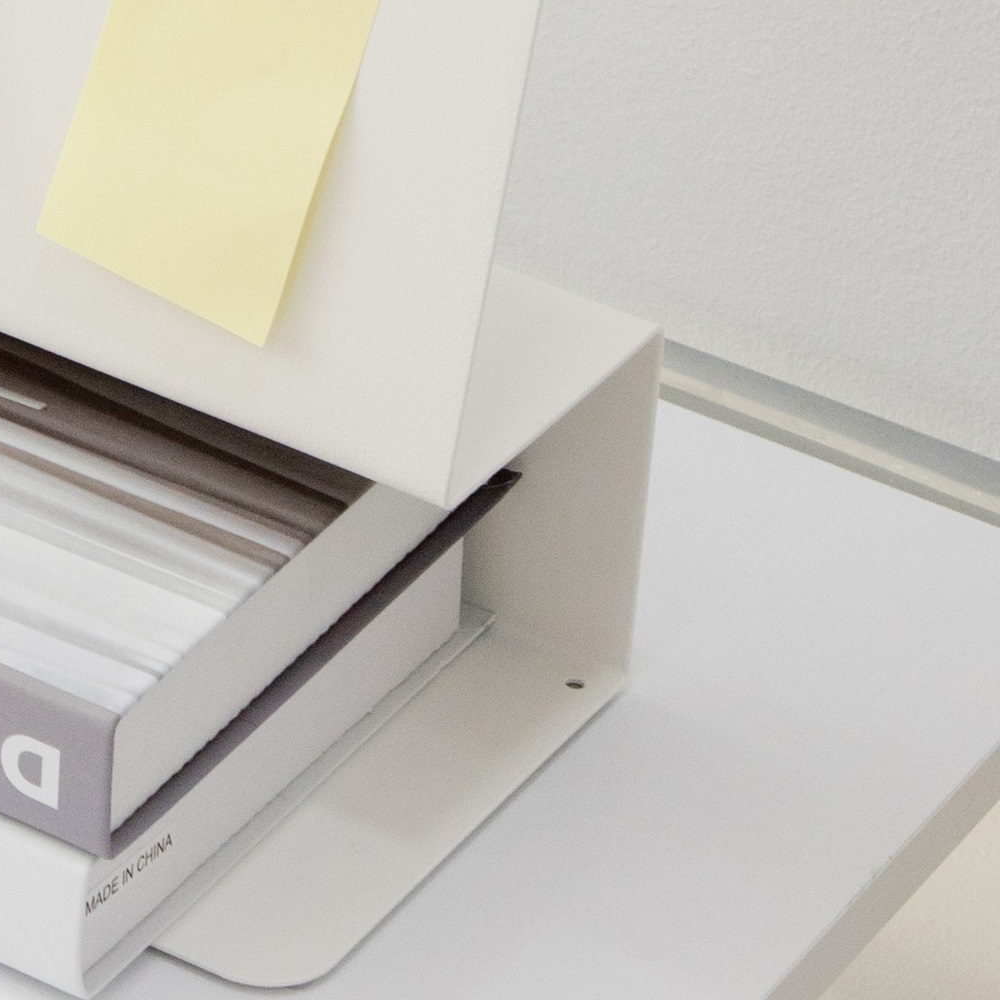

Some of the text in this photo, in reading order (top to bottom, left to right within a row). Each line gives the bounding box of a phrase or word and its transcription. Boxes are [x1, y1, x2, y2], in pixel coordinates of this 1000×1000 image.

[85, 832, 173, 917] MADE IN CHINA
